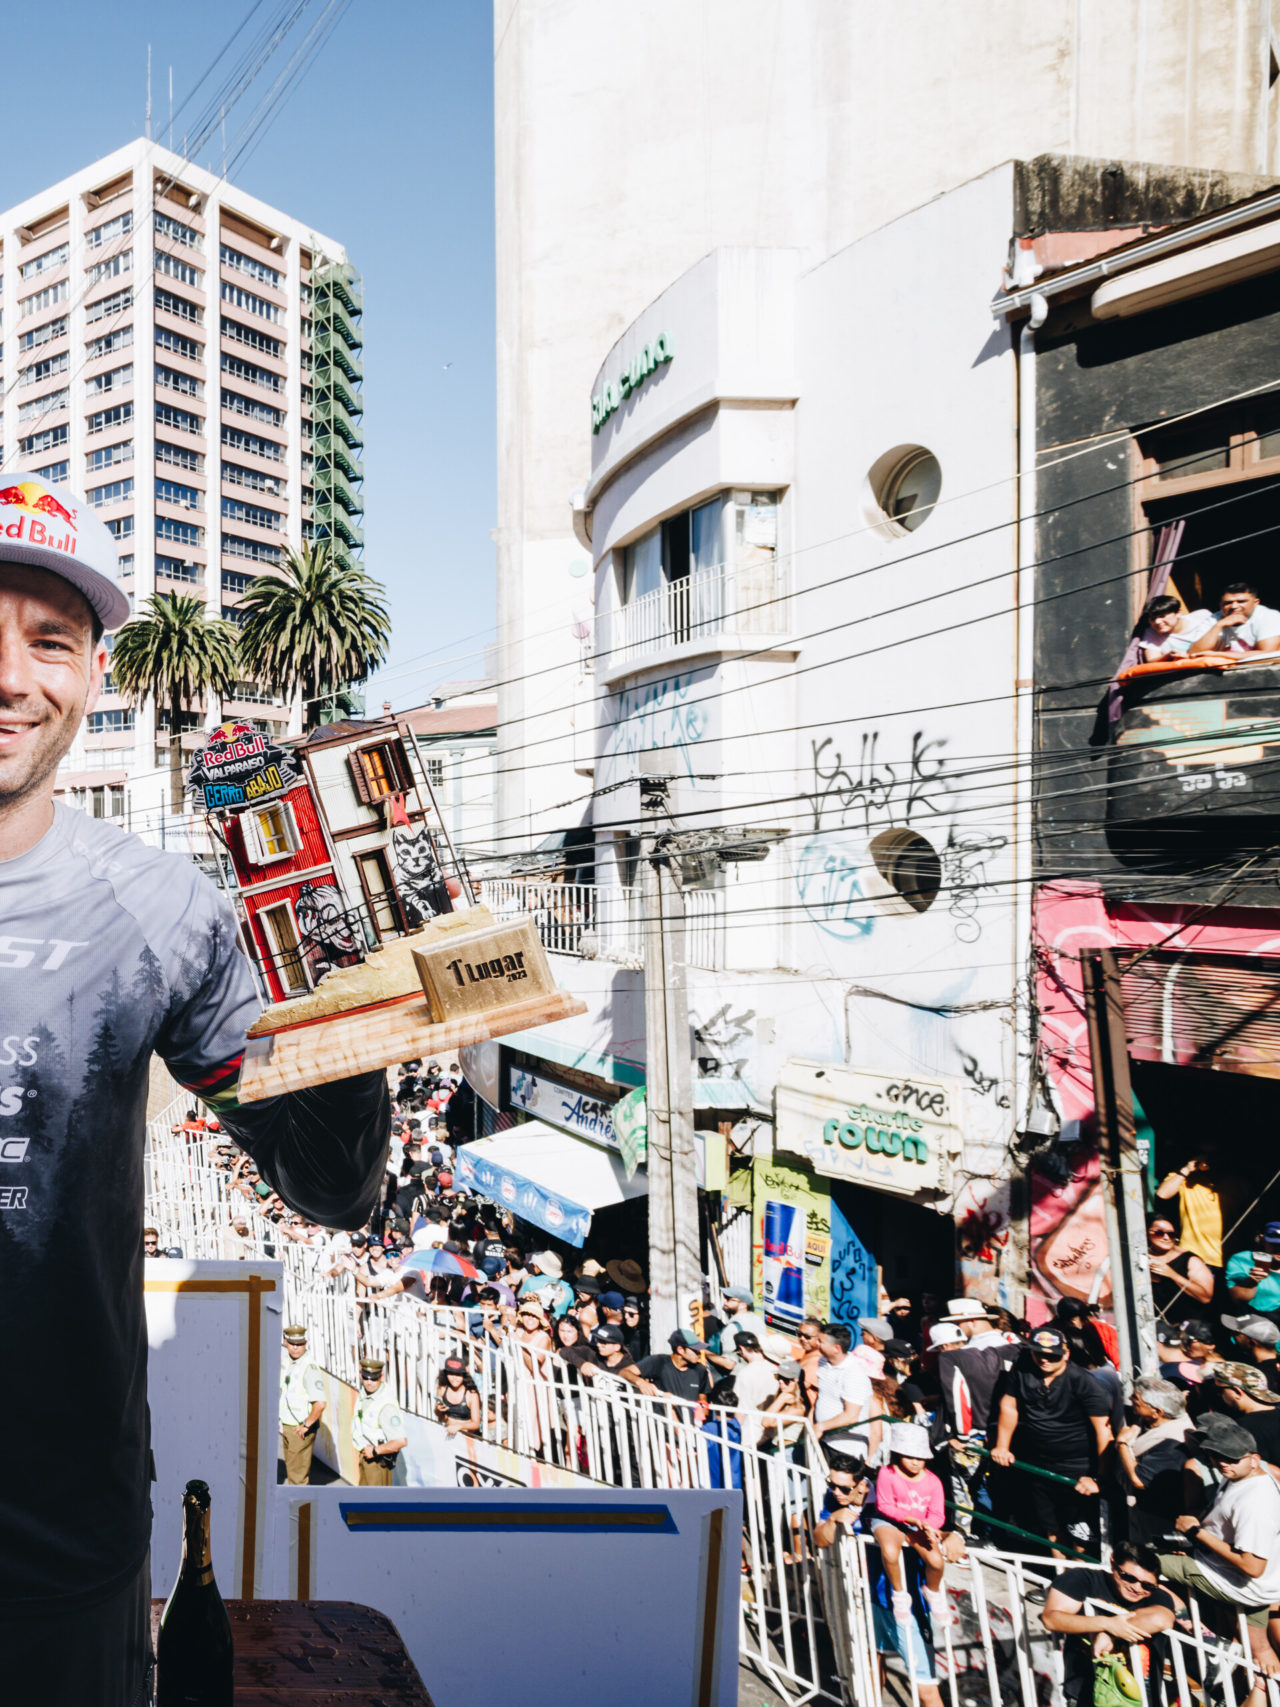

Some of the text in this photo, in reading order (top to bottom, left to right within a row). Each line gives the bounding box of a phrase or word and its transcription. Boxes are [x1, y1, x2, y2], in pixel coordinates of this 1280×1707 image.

[29, 519, 77, 554] Bull
[203, 735, 265, 767] Red Bull
[202, 756, 265, 781] VALPARAISO
[205, 765, 283, 808] CERRO ABAJO
[464, 951, 525, 983] Lugar
[506, 969, 528, 982] 2023
[847, 1104, 924, 1132] charlie
[764, 1238, 785, 1255] Red
